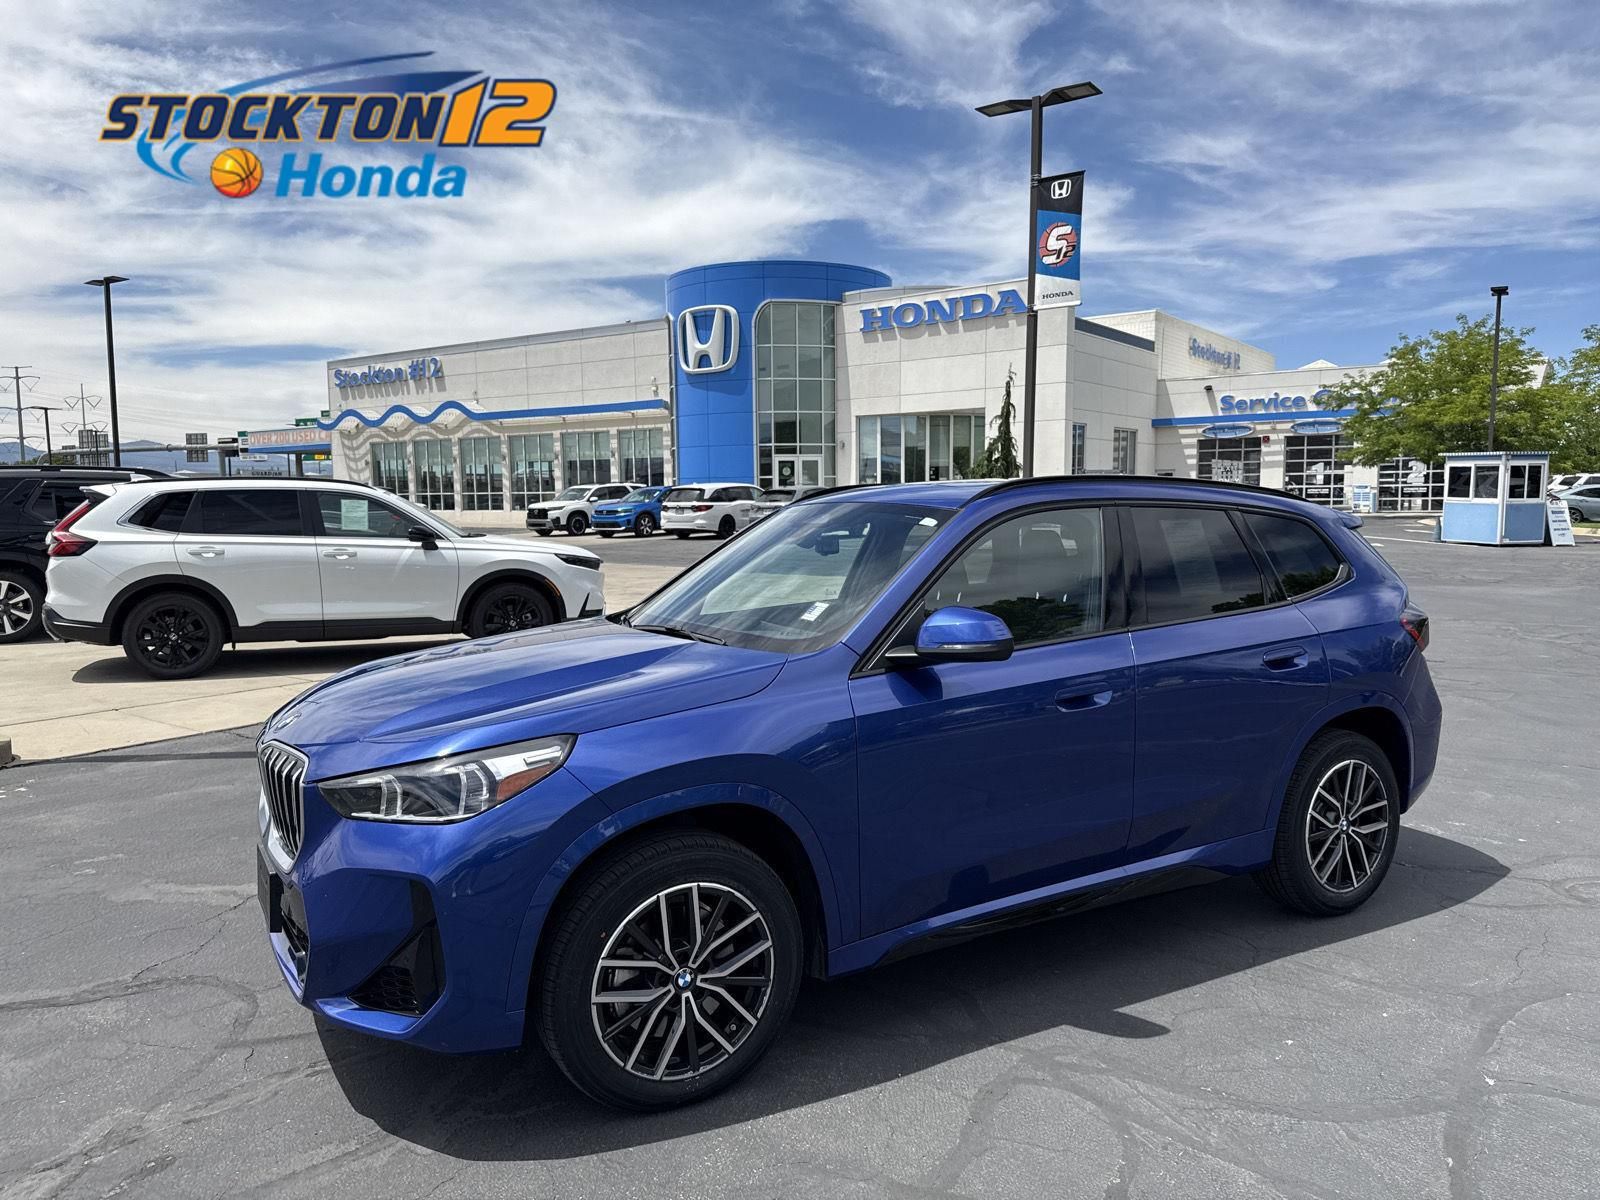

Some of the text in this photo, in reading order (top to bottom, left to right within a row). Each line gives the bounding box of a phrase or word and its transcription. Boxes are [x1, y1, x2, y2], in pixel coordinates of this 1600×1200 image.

[1042, 290, 1074, 299] HONDA
[860, 288, 1028, 333] HONDA
[334, 357, 442, 388] Stockton #12
[1220, 391, 1307, 414] Service
[292, 430, 316, 442] USED
[1407, 460, 1427, 483] 2
